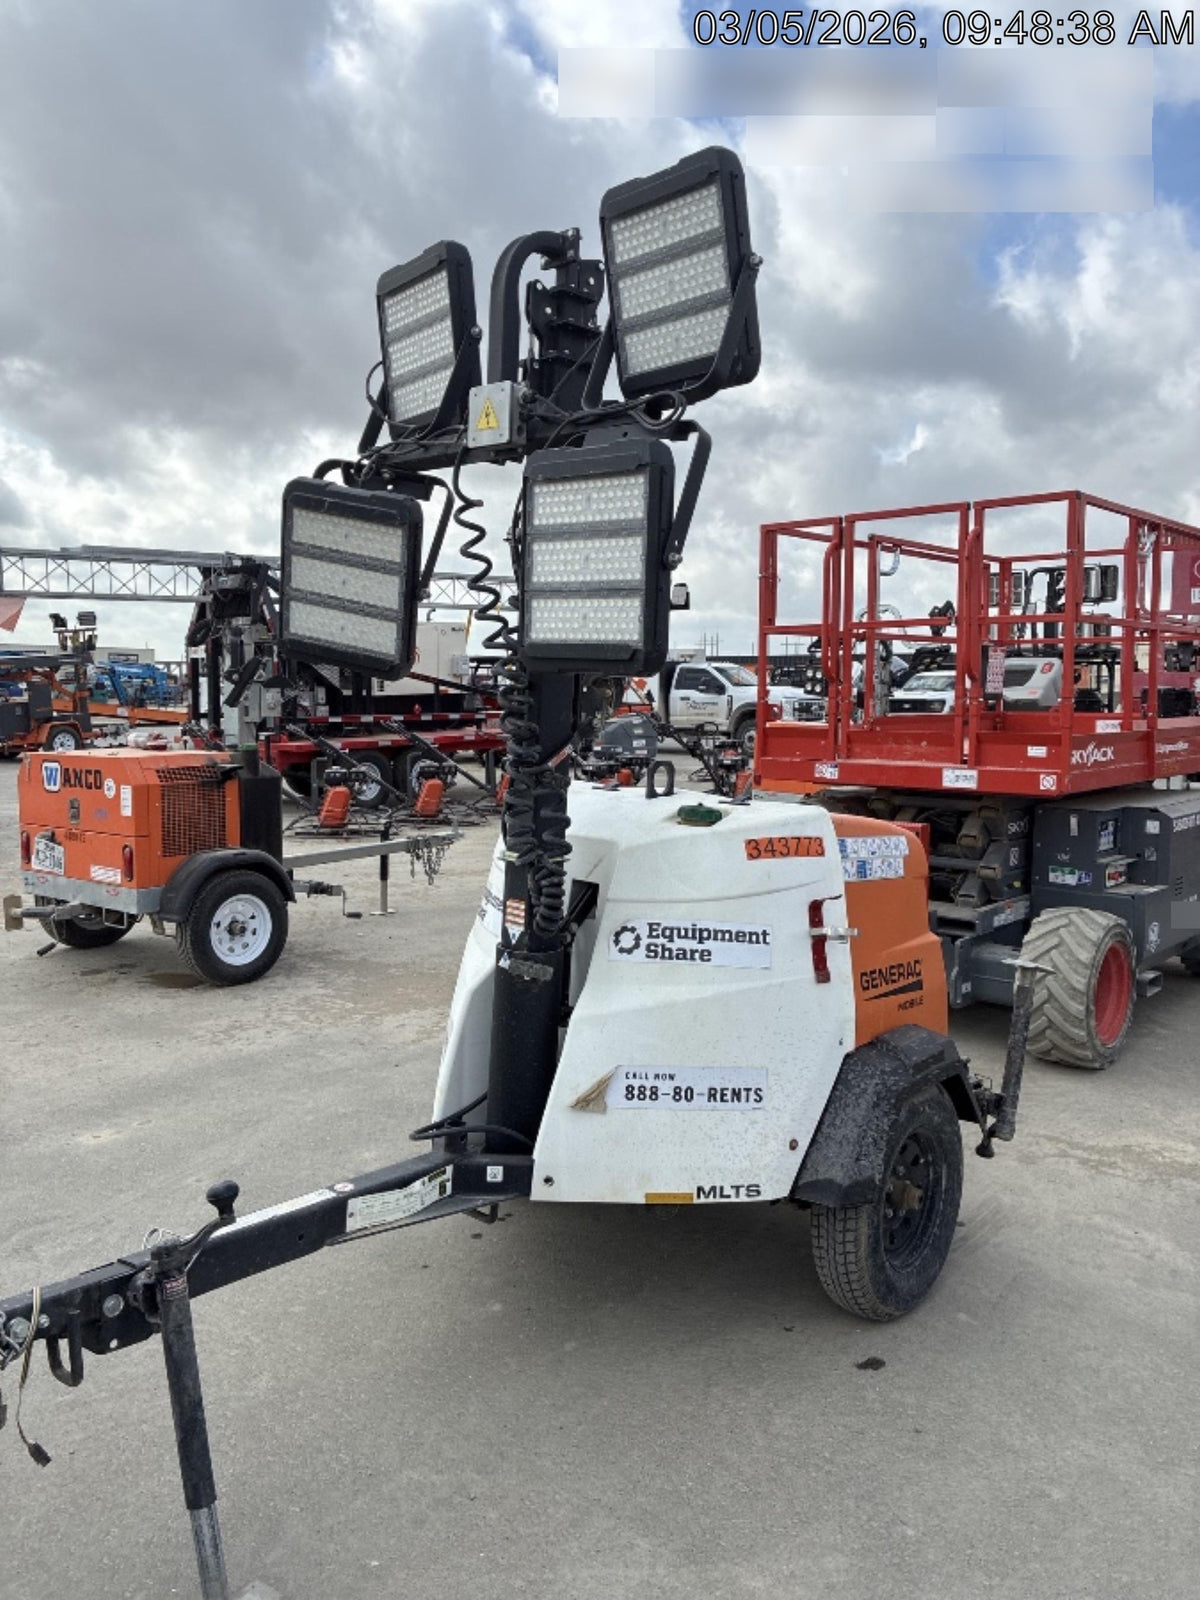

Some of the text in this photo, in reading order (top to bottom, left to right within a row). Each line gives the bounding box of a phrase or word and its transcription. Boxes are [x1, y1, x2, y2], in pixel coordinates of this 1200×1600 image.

[43, 761, 102, 792] WANCO
[746, 837, 824, 859] 343773
[647, 922, 770, 945] Equipment
[645, 943, 712, 962] Share
[860, 959, 922, 991] GENERAC
[625, 1071, 676, 1082] CALL NOW
[624, 1084, 764, 1103] 888-80-RENTS
[696, 1184, 762, 1199] MLTS
